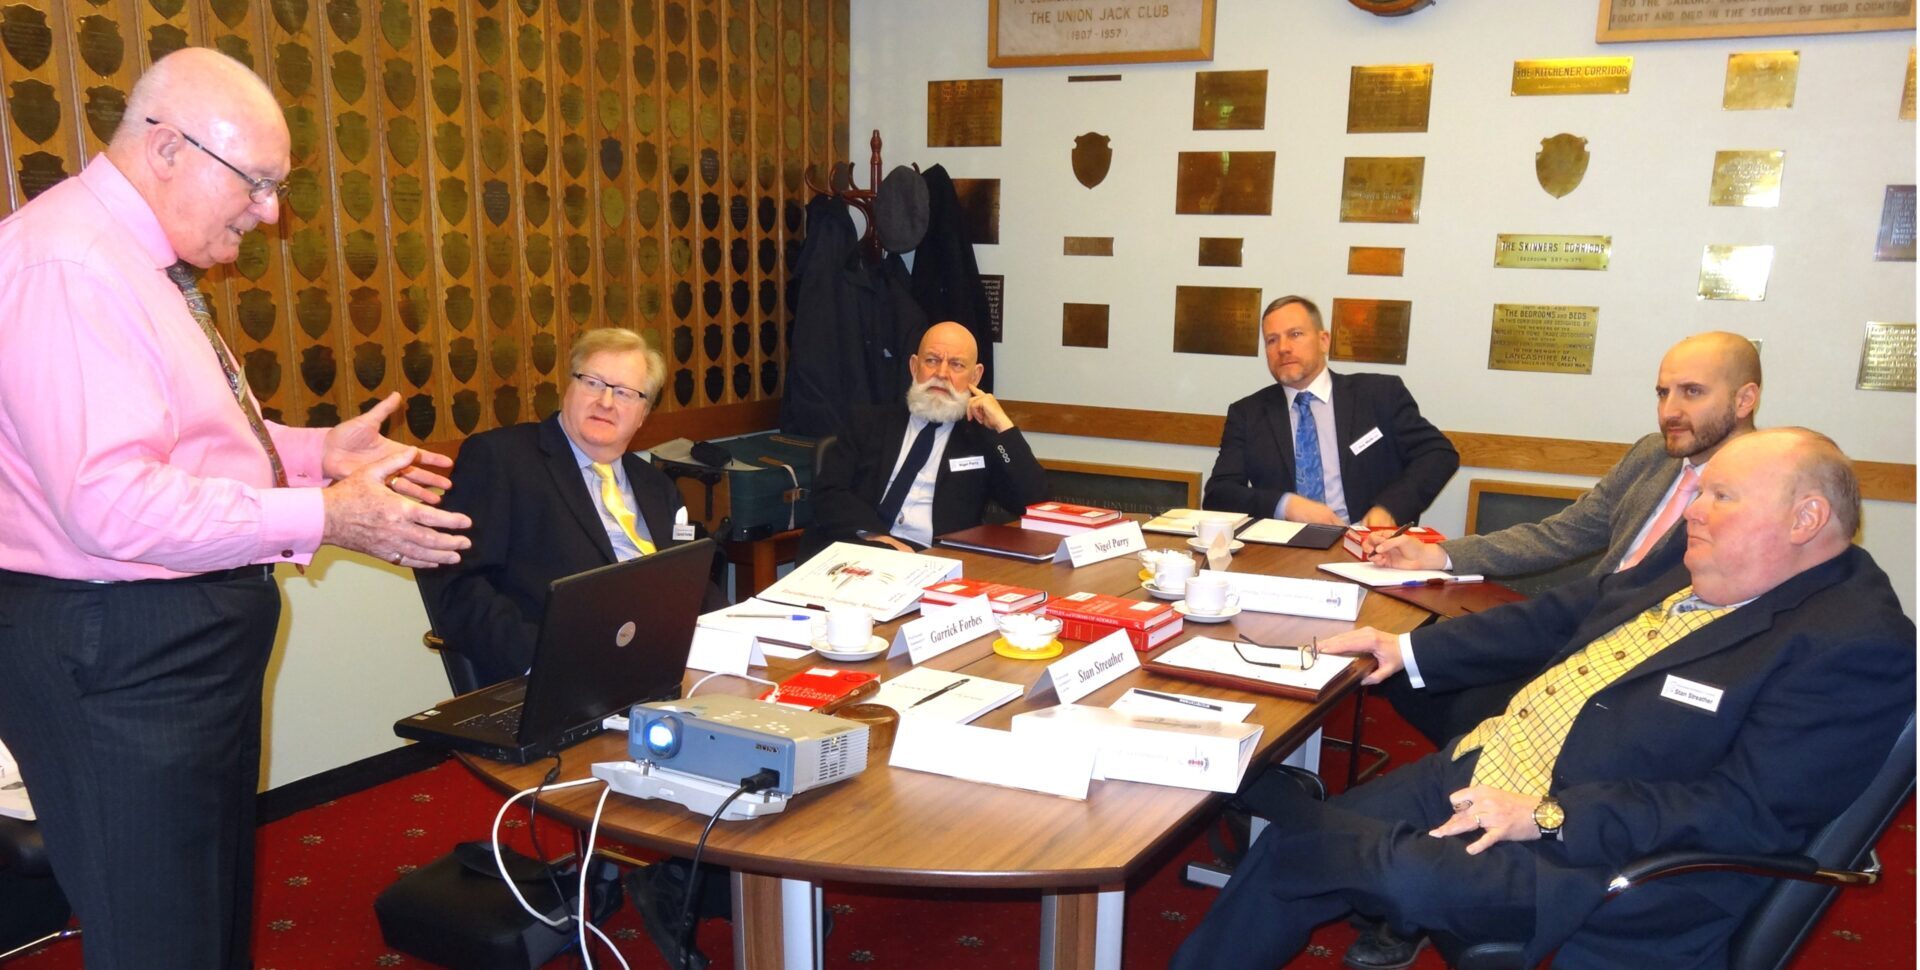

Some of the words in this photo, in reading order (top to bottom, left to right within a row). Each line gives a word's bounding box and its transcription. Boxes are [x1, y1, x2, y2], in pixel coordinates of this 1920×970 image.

[1030, 12, 1051, 24] THE
[1057, 9, 1093, 23] UNION
[1100, 8, 1131, 21] JACK
[1137, 5, 1170, 18] CLUB
[1611, 13, 1649, 23] FOUGHT
[1655, 11, 1674, 21] AND
[1725, 8, 1744, 18] THE
[1751, 6, 1792, 17] SERVICE
[1799, 5, 1813, 16] OF
[1820, 3, 1849, 13] THEIR
[1516, 67, 1531, 78] THE
[1535, 66, 1582, 78] KITCHENER
[1584, 65, 1628, 76] CORRIDOR
[1502, 241, 1515, 252] THE
[1564, 242, 1605, 254] CORRIDOR
[1504, 308, 1518, 318] THE
[1519, 310, 1556, 319] BEDROOMS
[1568, 311, 1587, 320] BEDS
[1504, 352, 1558, 362] LANCASHIRE
[1560, 354, 1577, 362] MEN
[1094, 540, 1111, 553] Nigel
[1112, 537, 1129, 549] Parry
[930, 622, 958, 644] Garrick
[958, 615, 983, 632] Forbes
[1077, 668, 1095, 684] Stan
[1093, 652, 1124, 675] Streather
